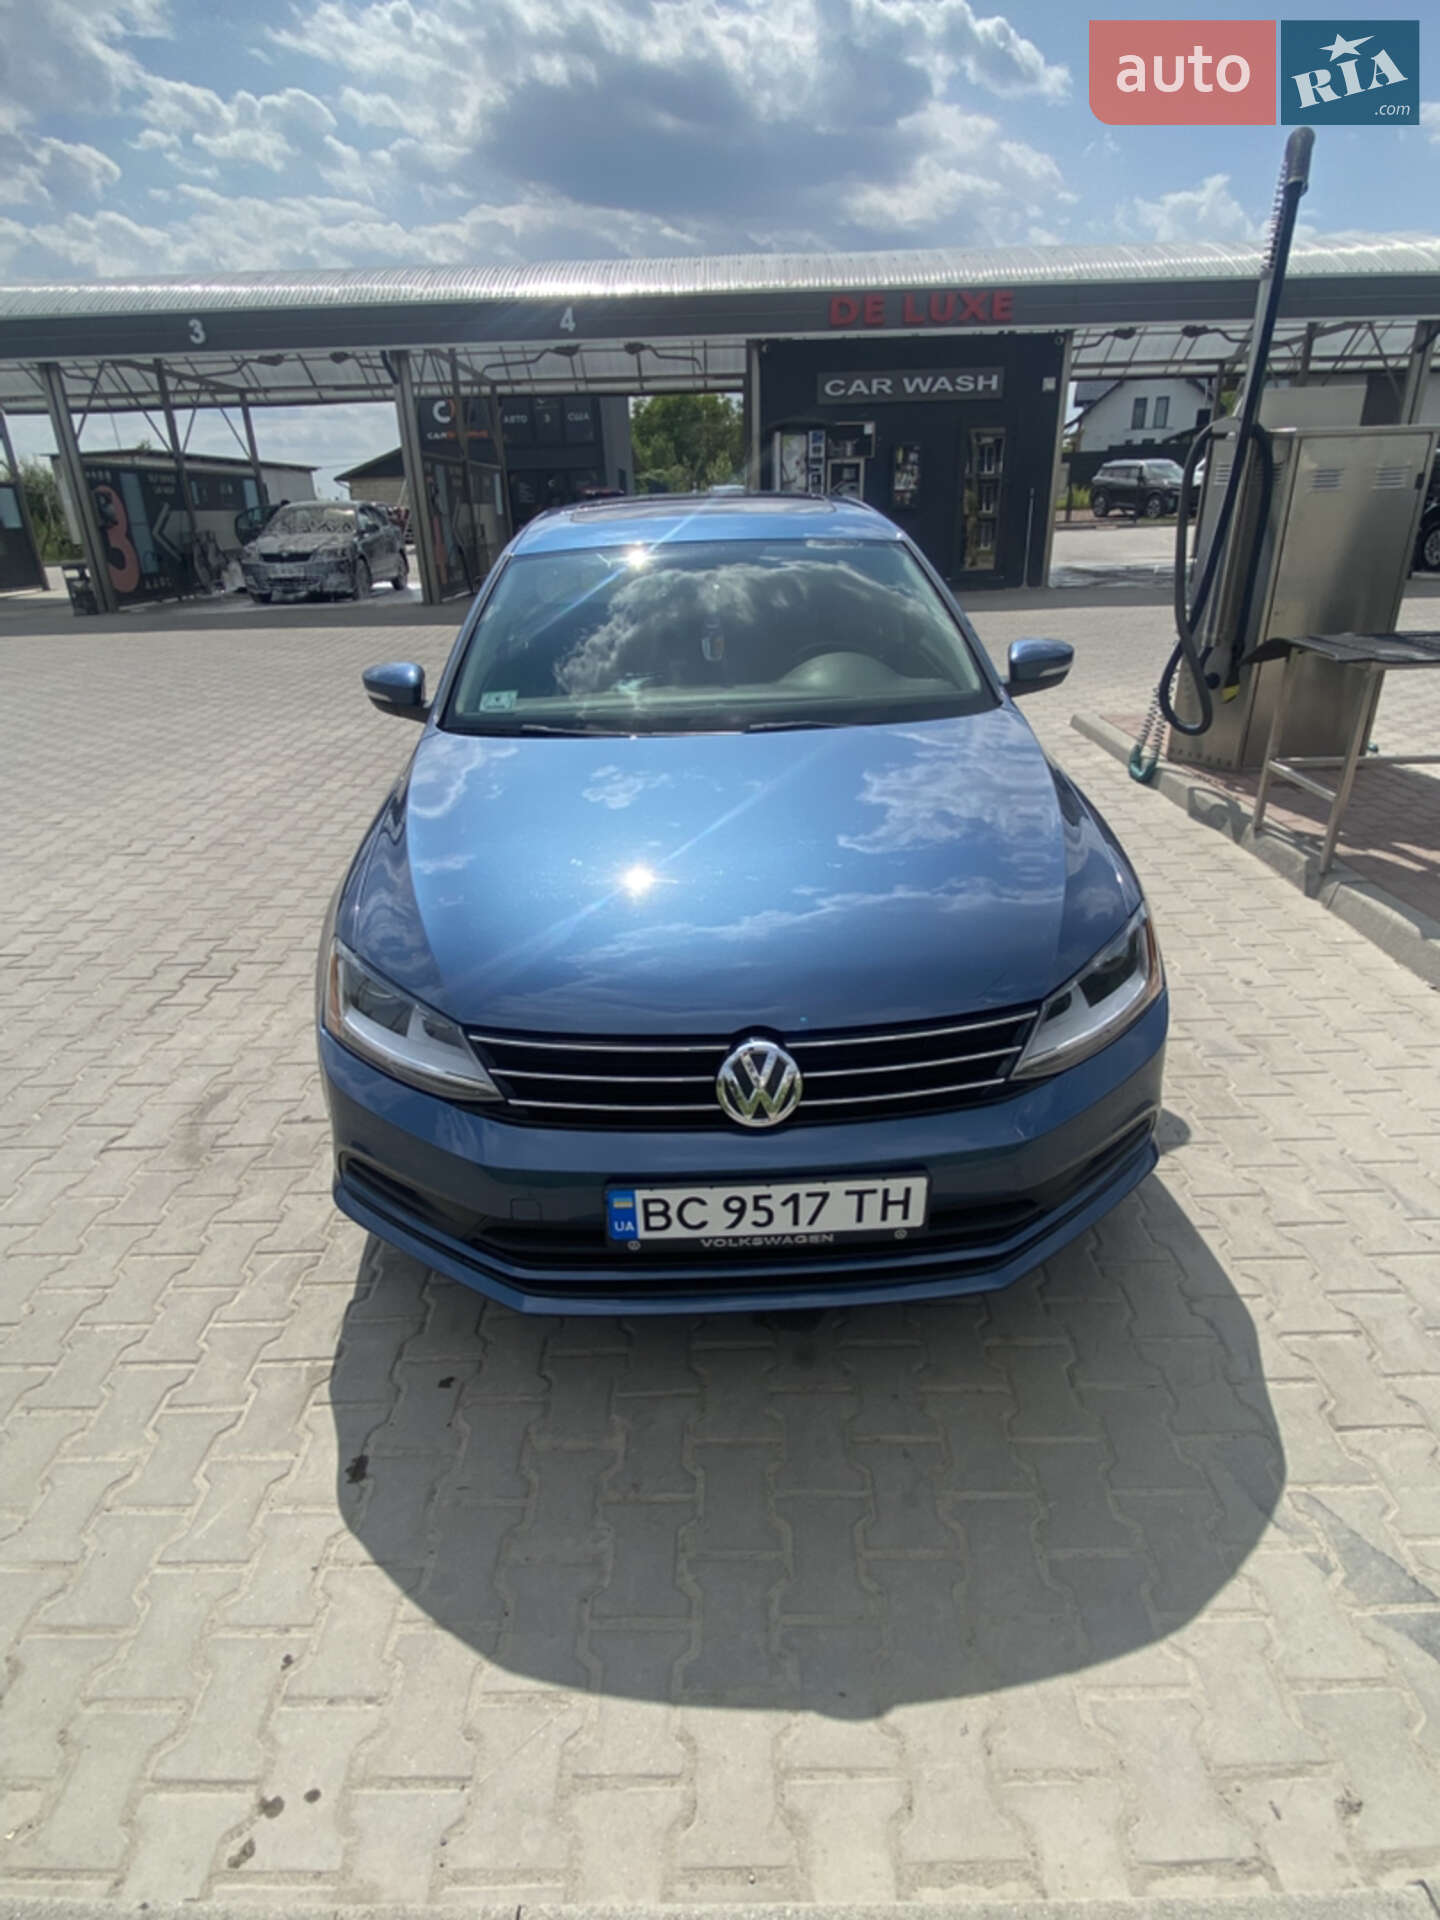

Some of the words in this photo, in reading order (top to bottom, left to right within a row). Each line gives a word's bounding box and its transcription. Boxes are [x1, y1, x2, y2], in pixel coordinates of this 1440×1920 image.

[560, 307, 576, 332] 4
[830, 293, 885, 325] DE
[903, 291, 1014, 322] LUXE
[189, 318, 206, 346] 3
[824, 378, 893, 396] CAR
[902, 374, 999, 393] WASH
[642, 1196, 709, 1231] BC
[722, 1191, 830, 1230] 9517
[844, 1186, 913, 1223] TH
[615, 1221, 635, 1232] UA
[700, 1233, 835, 1247] VOLKSWAGEN
